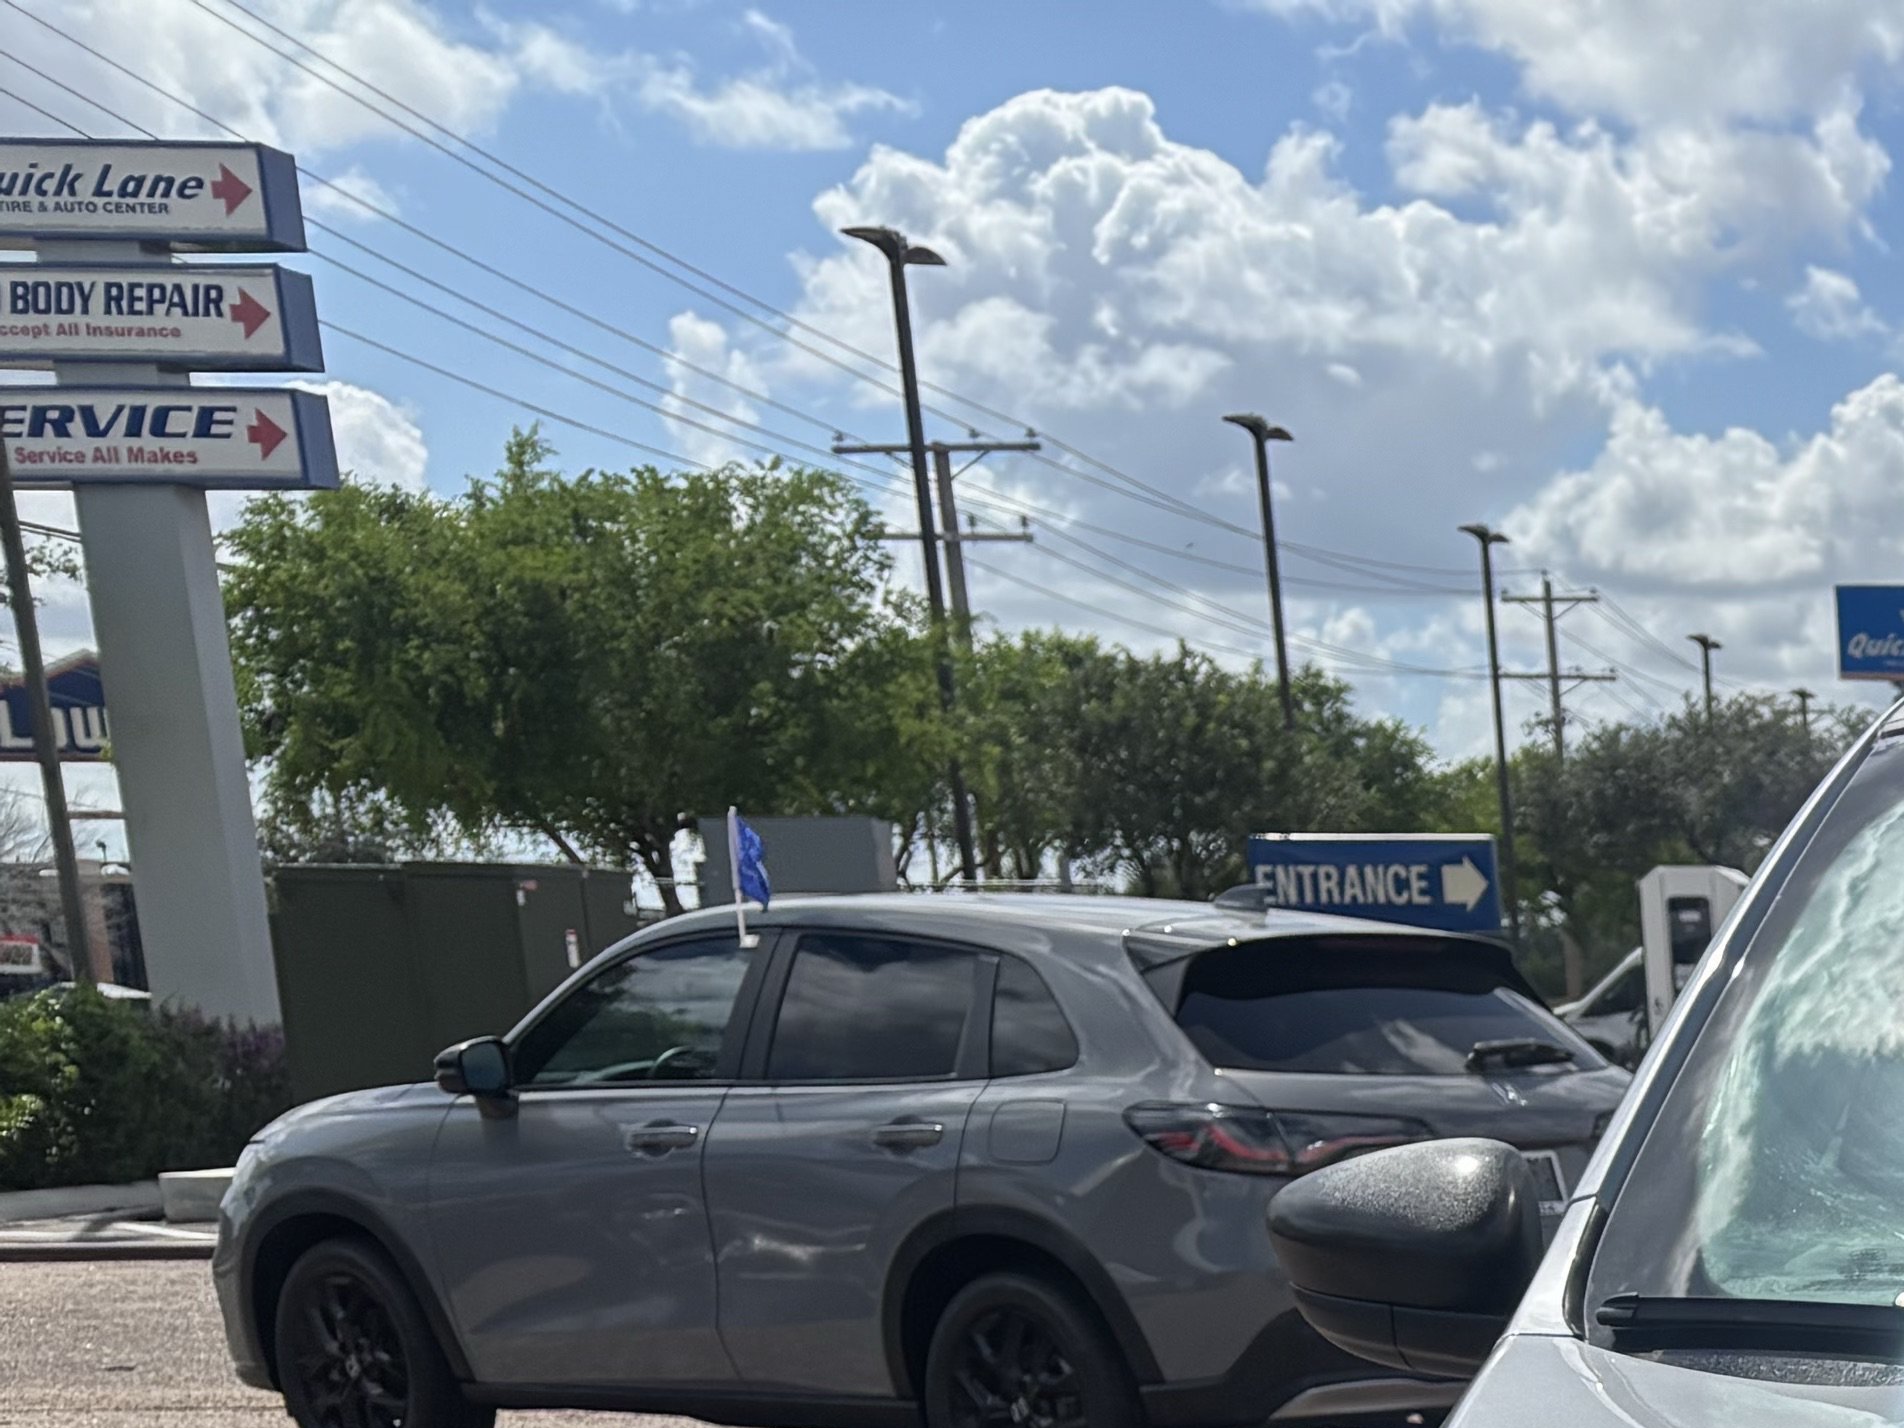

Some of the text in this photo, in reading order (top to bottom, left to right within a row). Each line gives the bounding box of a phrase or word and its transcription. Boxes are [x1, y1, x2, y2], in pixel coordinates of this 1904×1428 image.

[91, 163, 205, 199] Lane
[38, 201, 48, 213] &
[53, 201, 98, 214] AUTO
[103, 201, 169, 214] CENTER
[10, 281, 224, 318] BODY REPAIR
[56, 323, 80, 337] All
[86, 324, 182, 338] Insurance
[14, 446, 199, 465] Service All Makes
[1255, 864, 1431, 905] ENTRANCE
